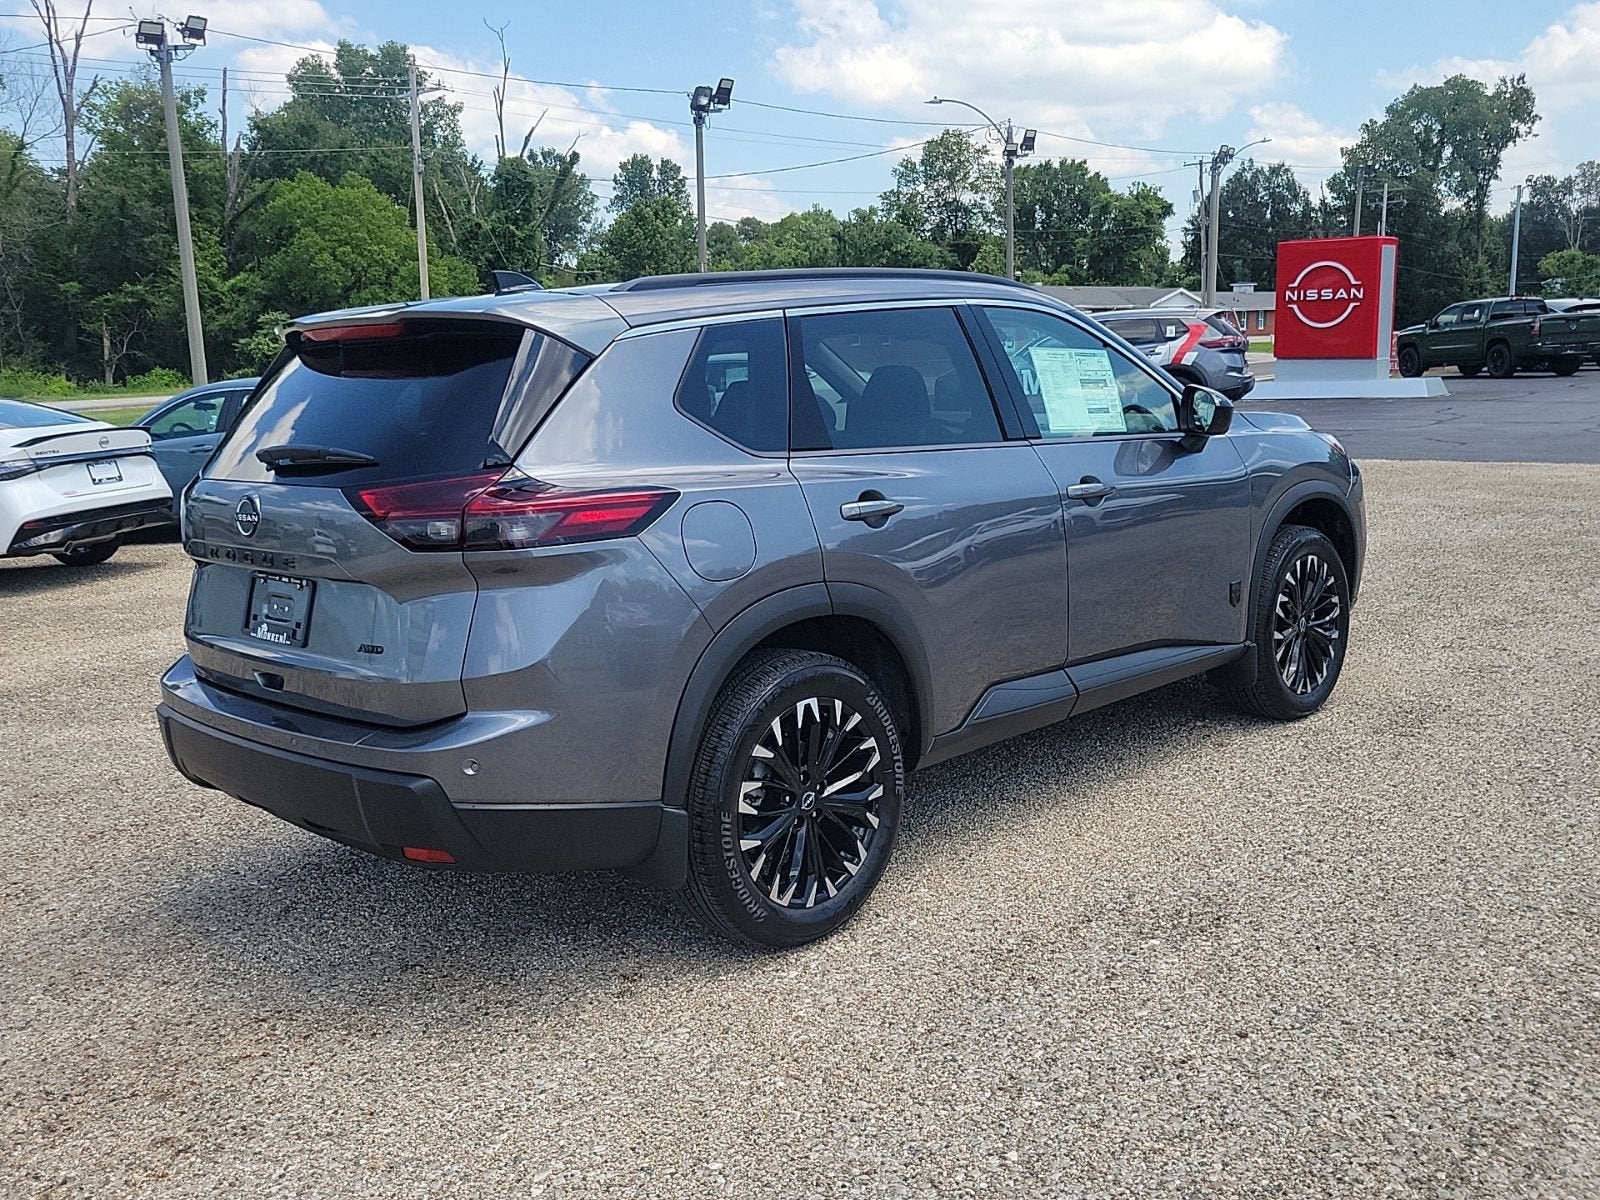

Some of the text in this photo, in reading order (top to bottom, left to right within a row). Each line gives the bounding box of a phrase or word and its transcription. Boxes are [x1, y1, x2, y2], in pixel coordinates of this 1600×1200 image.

[1286, 288, 1363, 301] NISSAN
[209, 546, 297, 569] ROGUE
[865, 690, 904, 795] BRIDGESTONE
[720, 811, 769, 923] BRIDGESTONE
